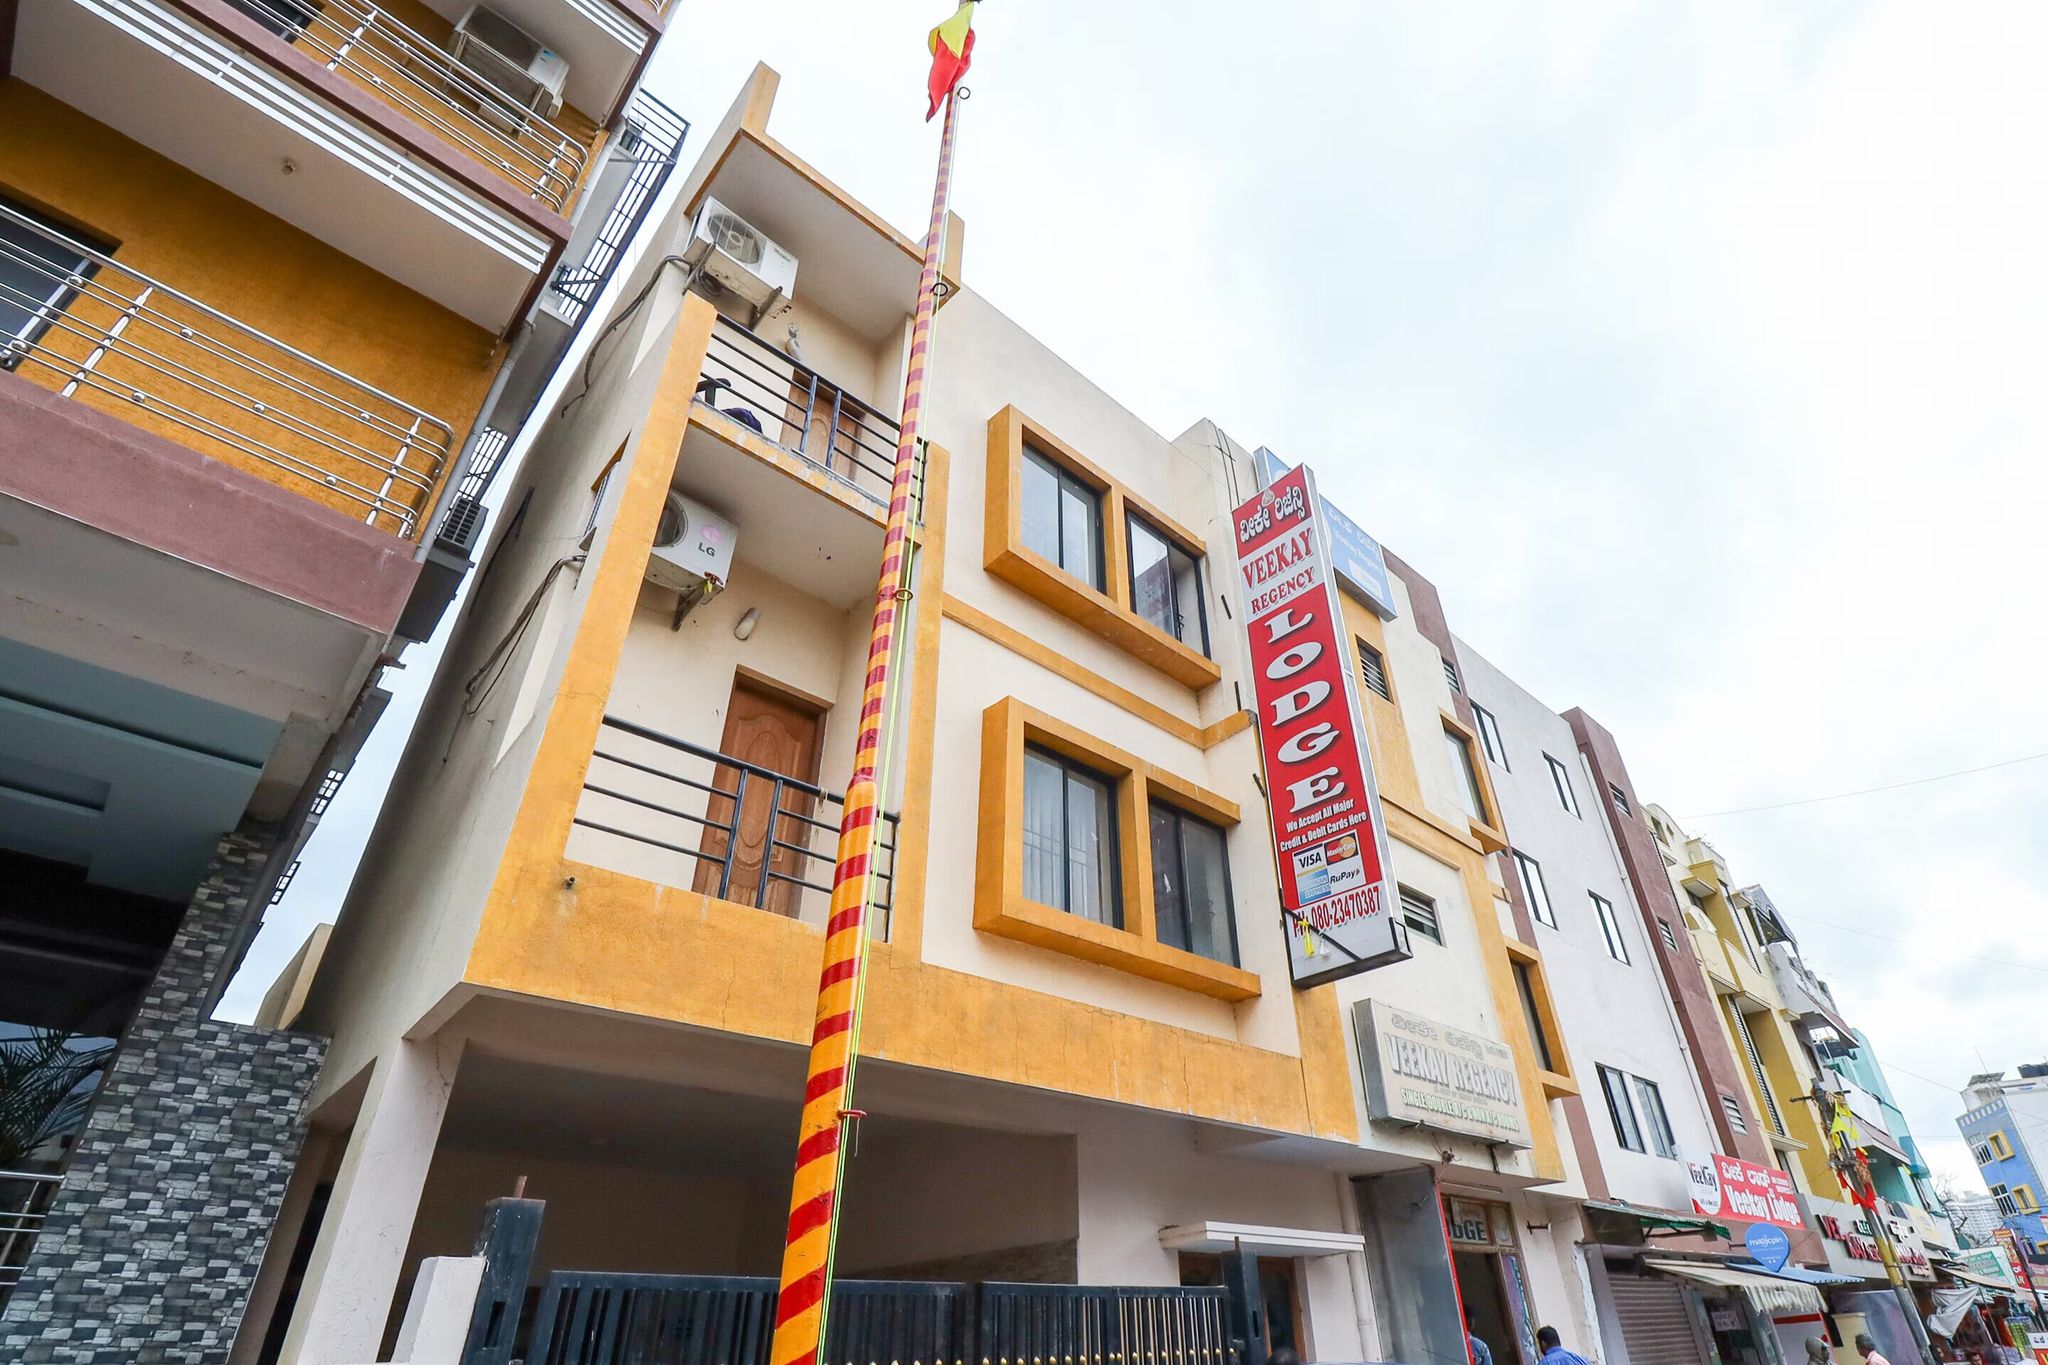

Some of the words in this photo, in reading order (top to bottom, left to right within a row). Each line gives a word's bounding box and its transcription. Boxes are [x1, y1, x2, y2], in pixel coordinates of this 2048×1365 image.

[698, 542, 716, 557] LG
[1242, 527, 1312, 589] VEEKAY
[1251, 566, 1313, 614] REGENCY
[1264, 608, 1345, 813] LODGE
[1280, 835, 1301, 852] Credit
[1302, 835, 1308, 843] &
[1308, 828, 1327, 841] Debit
[1327, 818, 1348, 834] Cards
[1348, 811, 1367, 826] Here
[1286, 820, 1298, 833] We
[1298, 811, 1322, 828] Accept
[1323, 806, 1332, 820] All
[1333, 799, 1354, 818] Major
[1298, 852, 1322, 868] VISA
[1330, 869, 1356, 884] RuPay
[1383, 1032, 1450, 1088] VEEKAY
[1448, 1052, 1517, 1107] REGENCY
[1723, 1184, 1771, 1221] Veekay
[1767, 1193, 1801, 1226] Lodge
